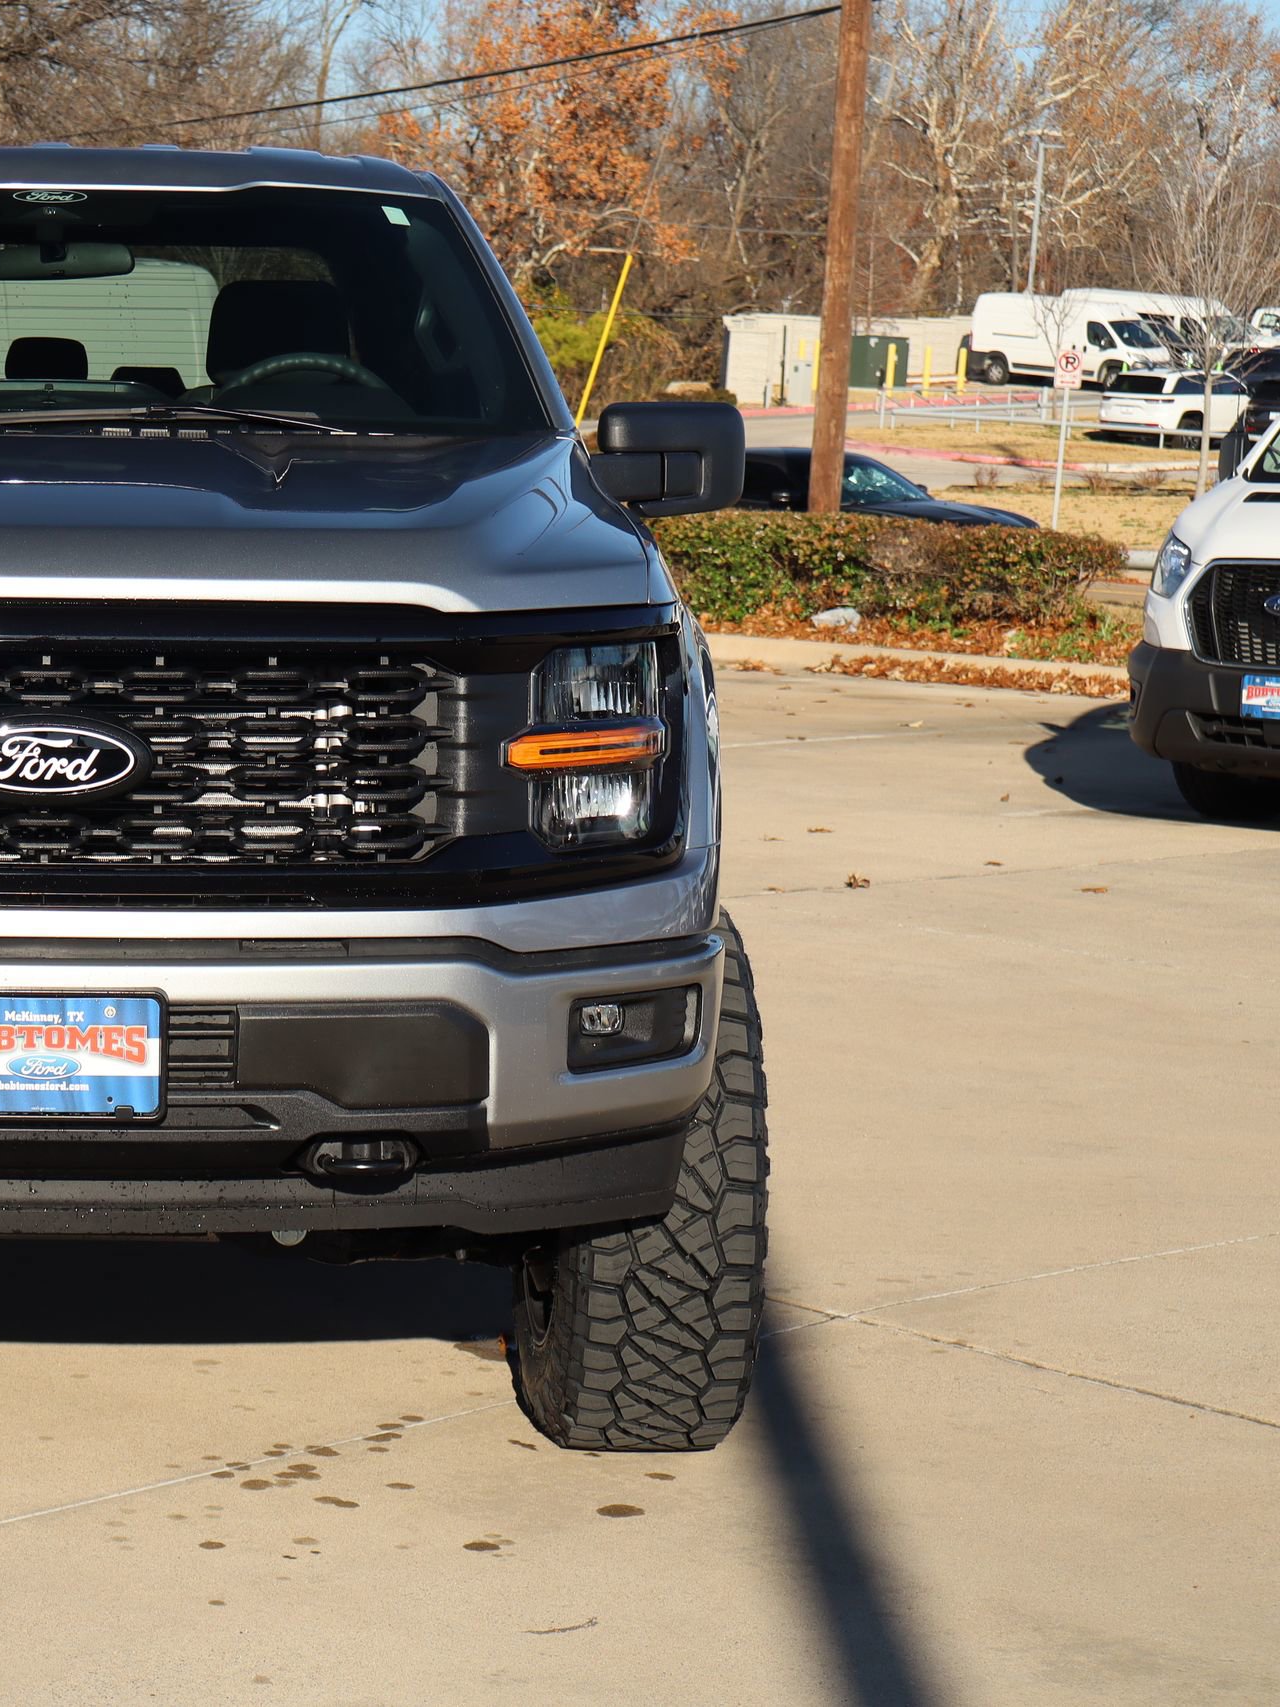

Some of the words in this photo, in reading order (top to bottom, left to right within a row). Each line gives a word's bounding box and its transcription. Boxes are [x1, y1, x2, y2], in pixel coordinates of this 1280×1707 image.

[26, 191, 74, 201] Ford
[67, 1011, 85, 1022] TX
[21, 1058, 67, 1075] Ford
